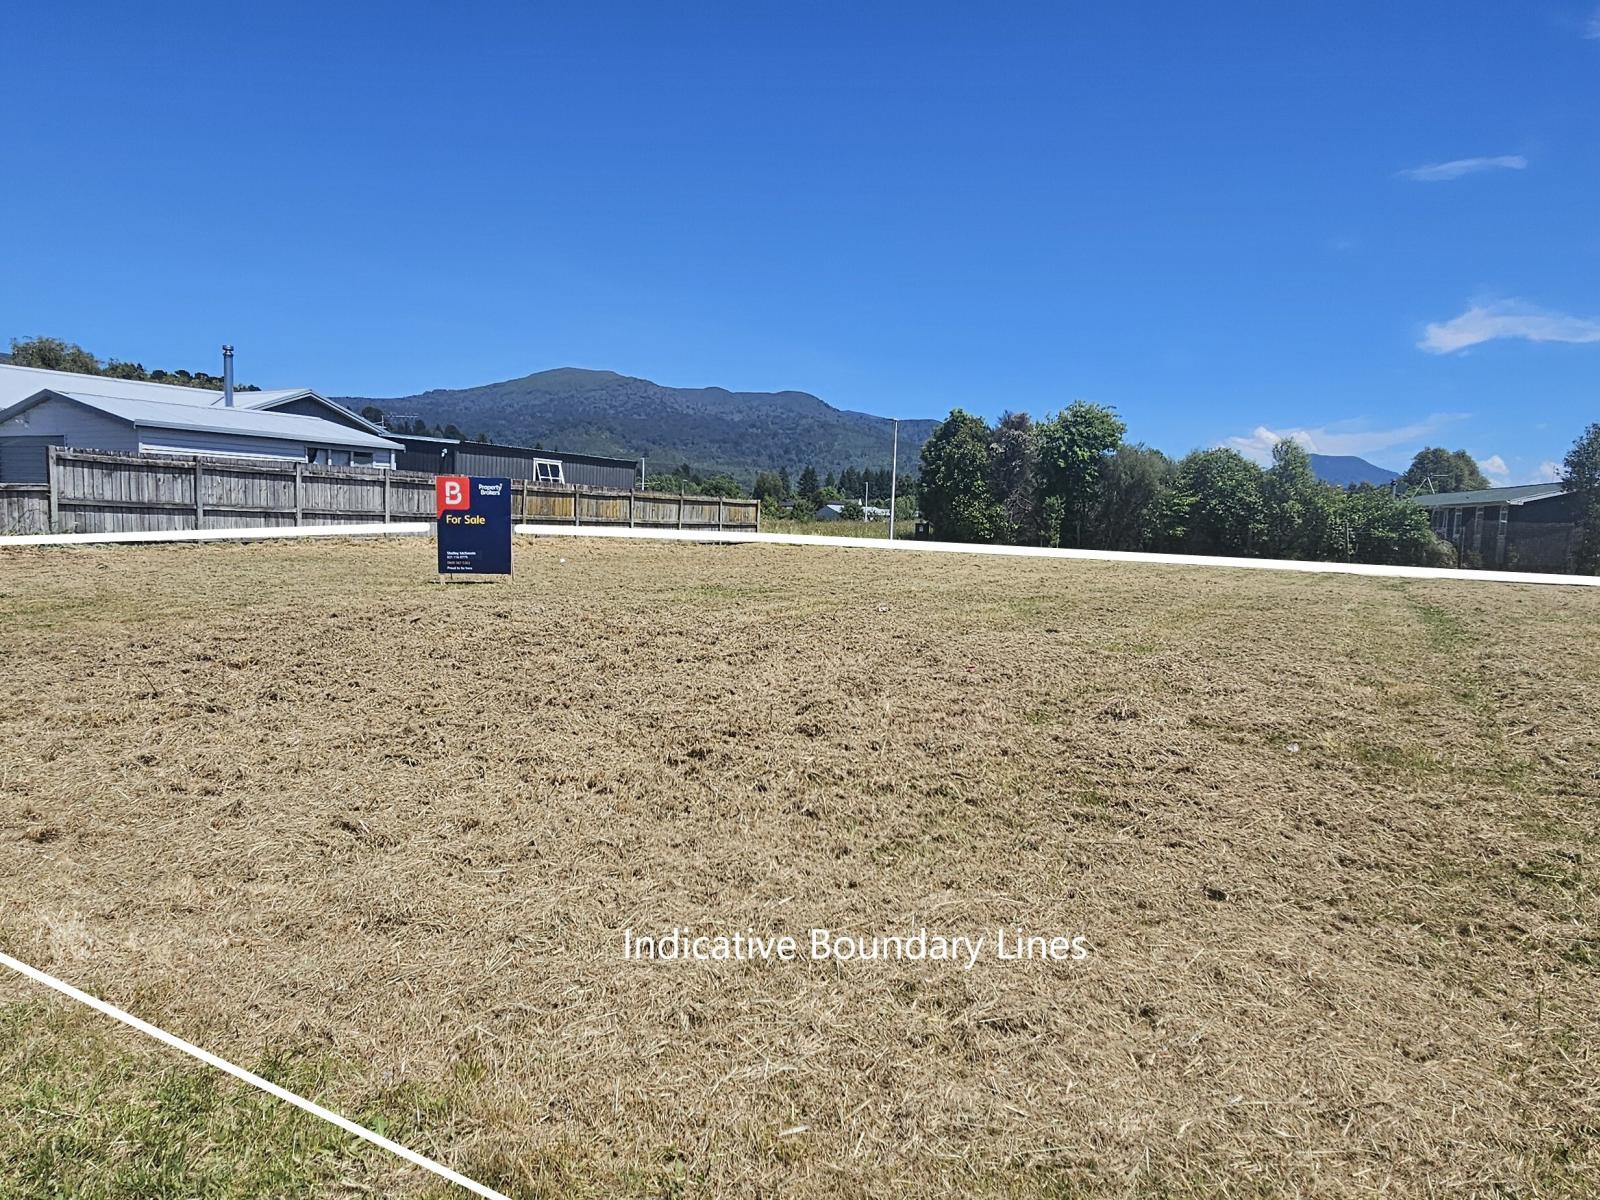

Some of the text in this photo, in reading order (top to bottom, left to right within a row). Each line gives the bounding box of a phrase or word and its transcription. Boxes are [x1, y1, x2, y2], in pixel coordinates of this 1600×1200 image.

[478, 483, 503, 491] Property
[445, 481, 462, 505] B
[446, 515, 486, 525] For Sale
